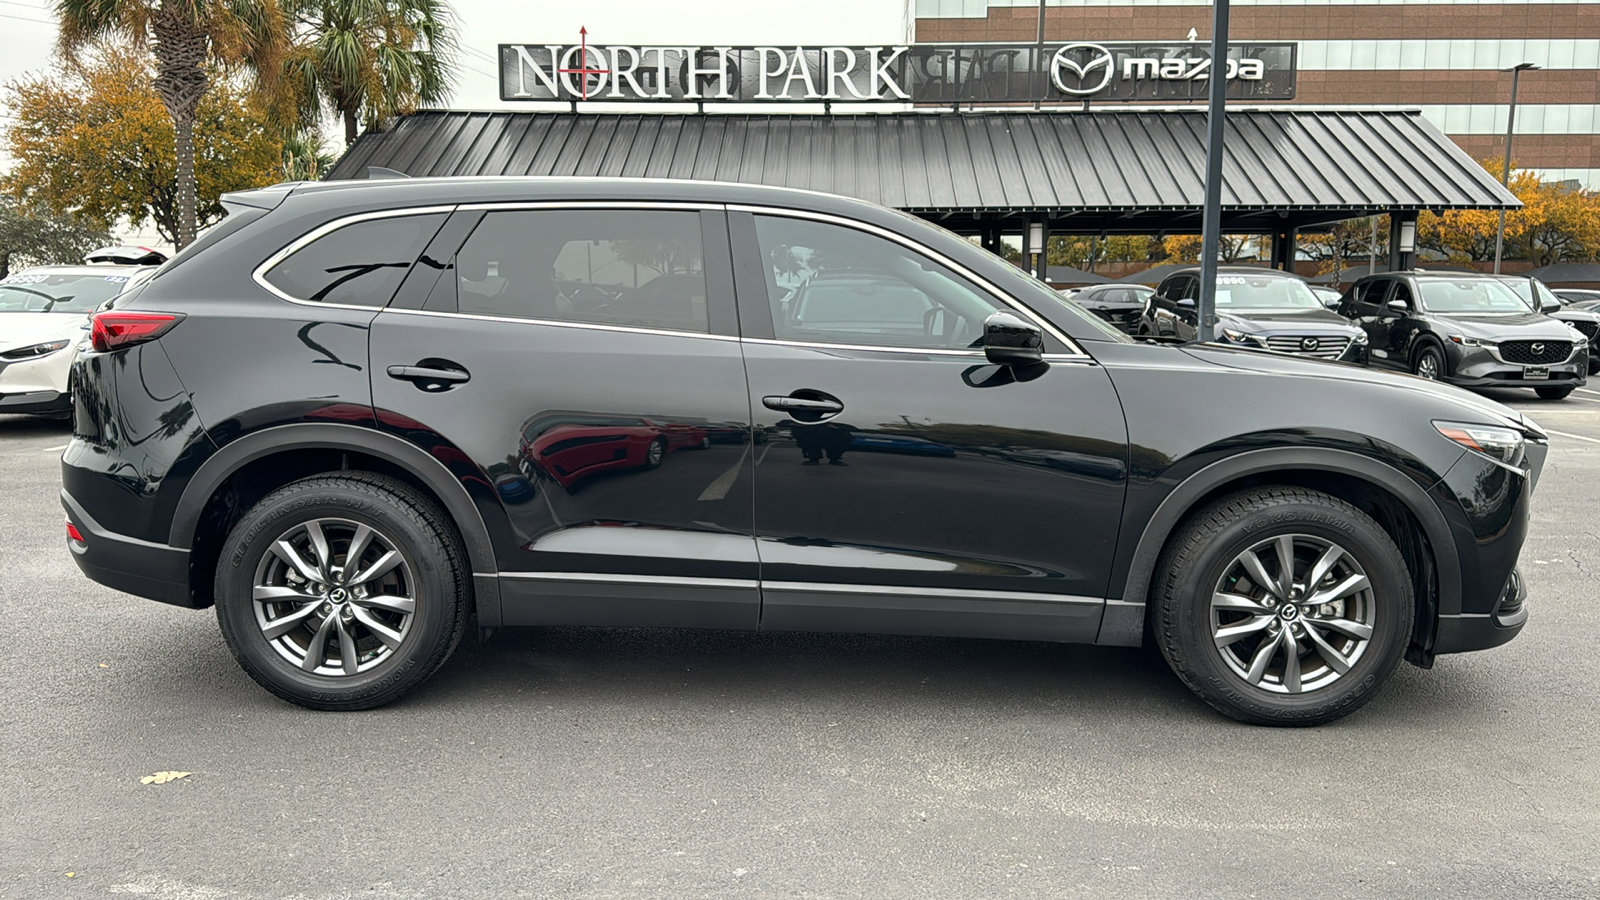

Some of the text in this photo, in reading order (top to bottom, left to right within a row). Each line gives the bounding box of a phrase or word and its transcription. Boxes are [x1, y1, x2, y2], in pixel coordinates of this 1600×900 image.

[510, 45, 733, 99] NORTH
[753, 46, 911, 99] PARK
[1241, 511, 1355, 534] YOKOHAMA
